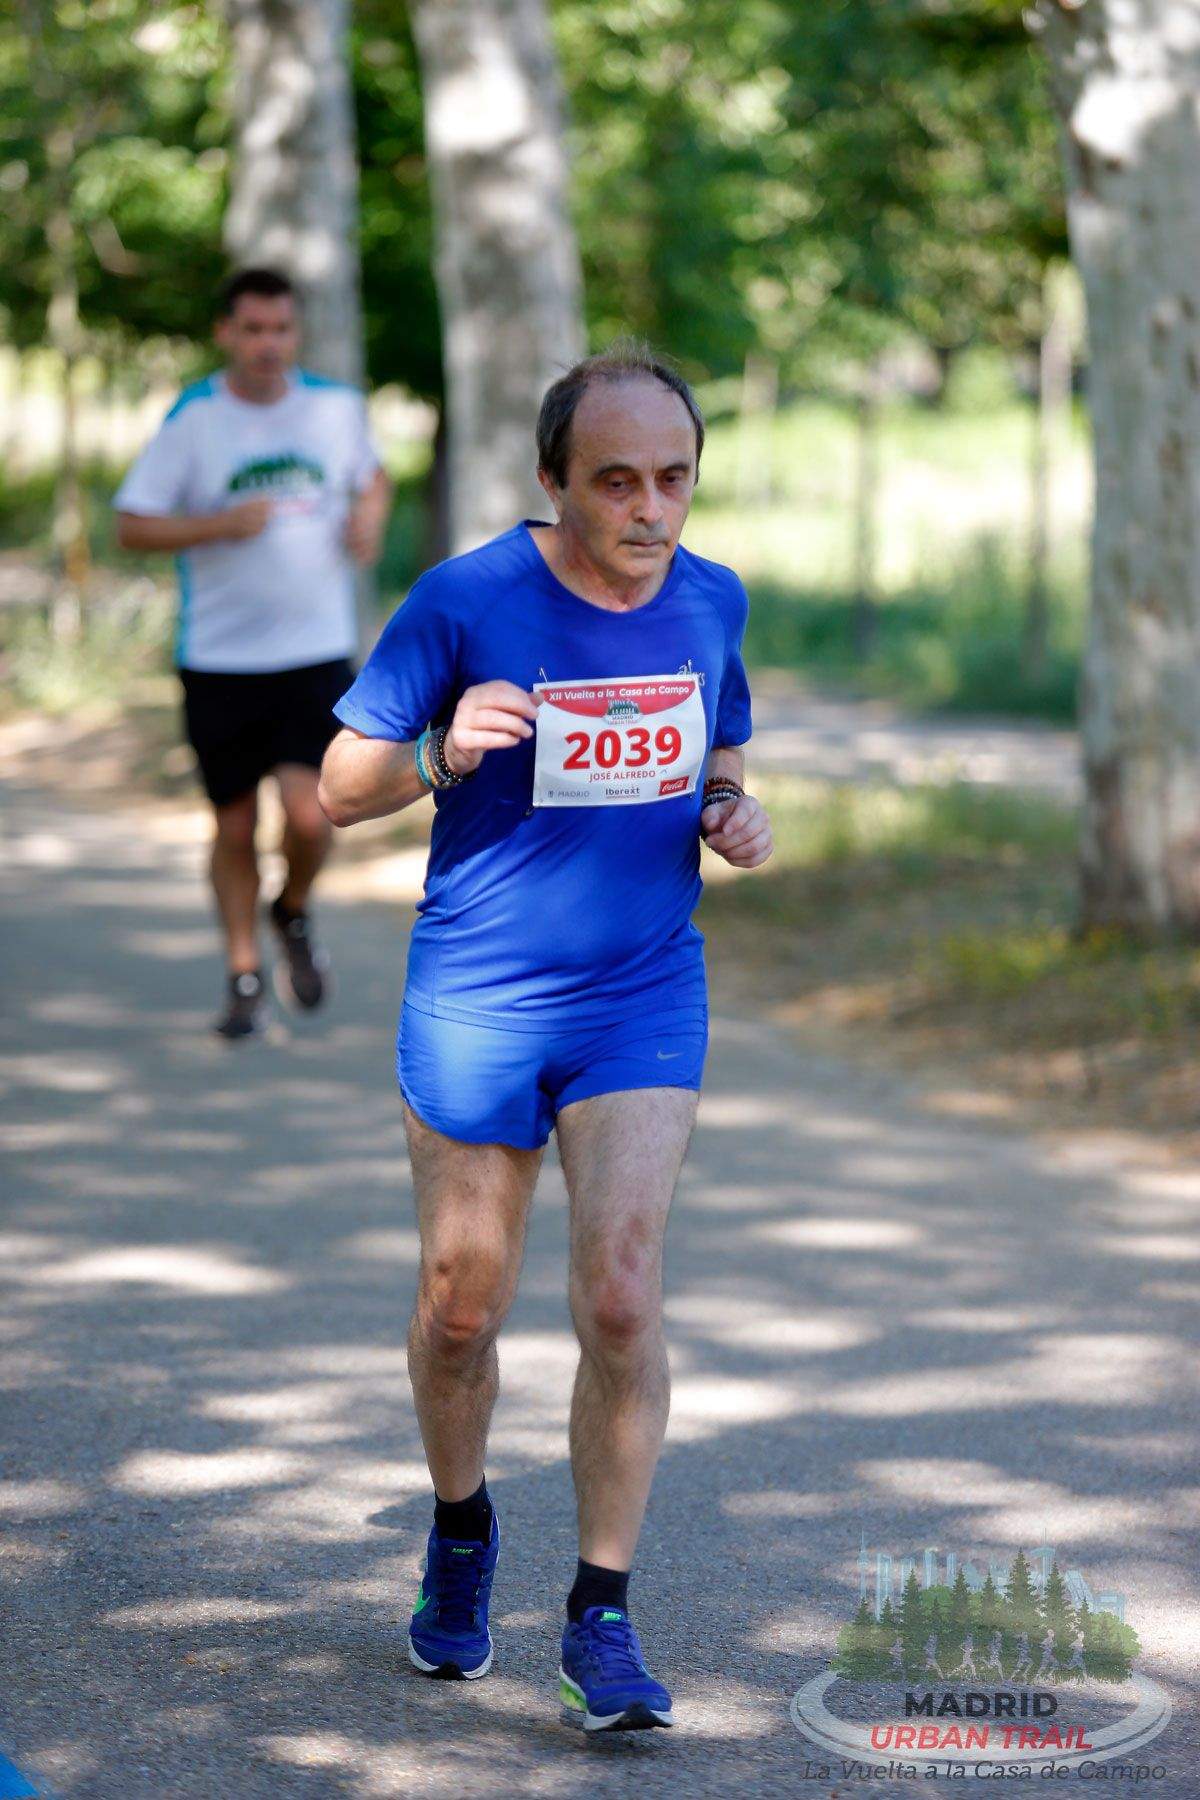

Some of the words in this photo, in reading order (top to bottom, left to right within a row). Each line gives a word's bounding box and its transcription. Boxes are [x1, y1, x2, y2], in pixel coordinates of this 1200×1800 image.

[549, 692, 562, 701] XII
[564, 690, 595, 700] Vuelta
[606, 688, 615, 697] la
[619, 687, 642, 697] Casa
[644, 686, 656, 695] de
[658, 685, 690, 696] Campo
[562, 725, 682, 771] 2039
[588, 770, 611, 783] JOSÉ
[613, 770, 656, 781] ALFREDO
[605, 787, 640, 796] Iberext
